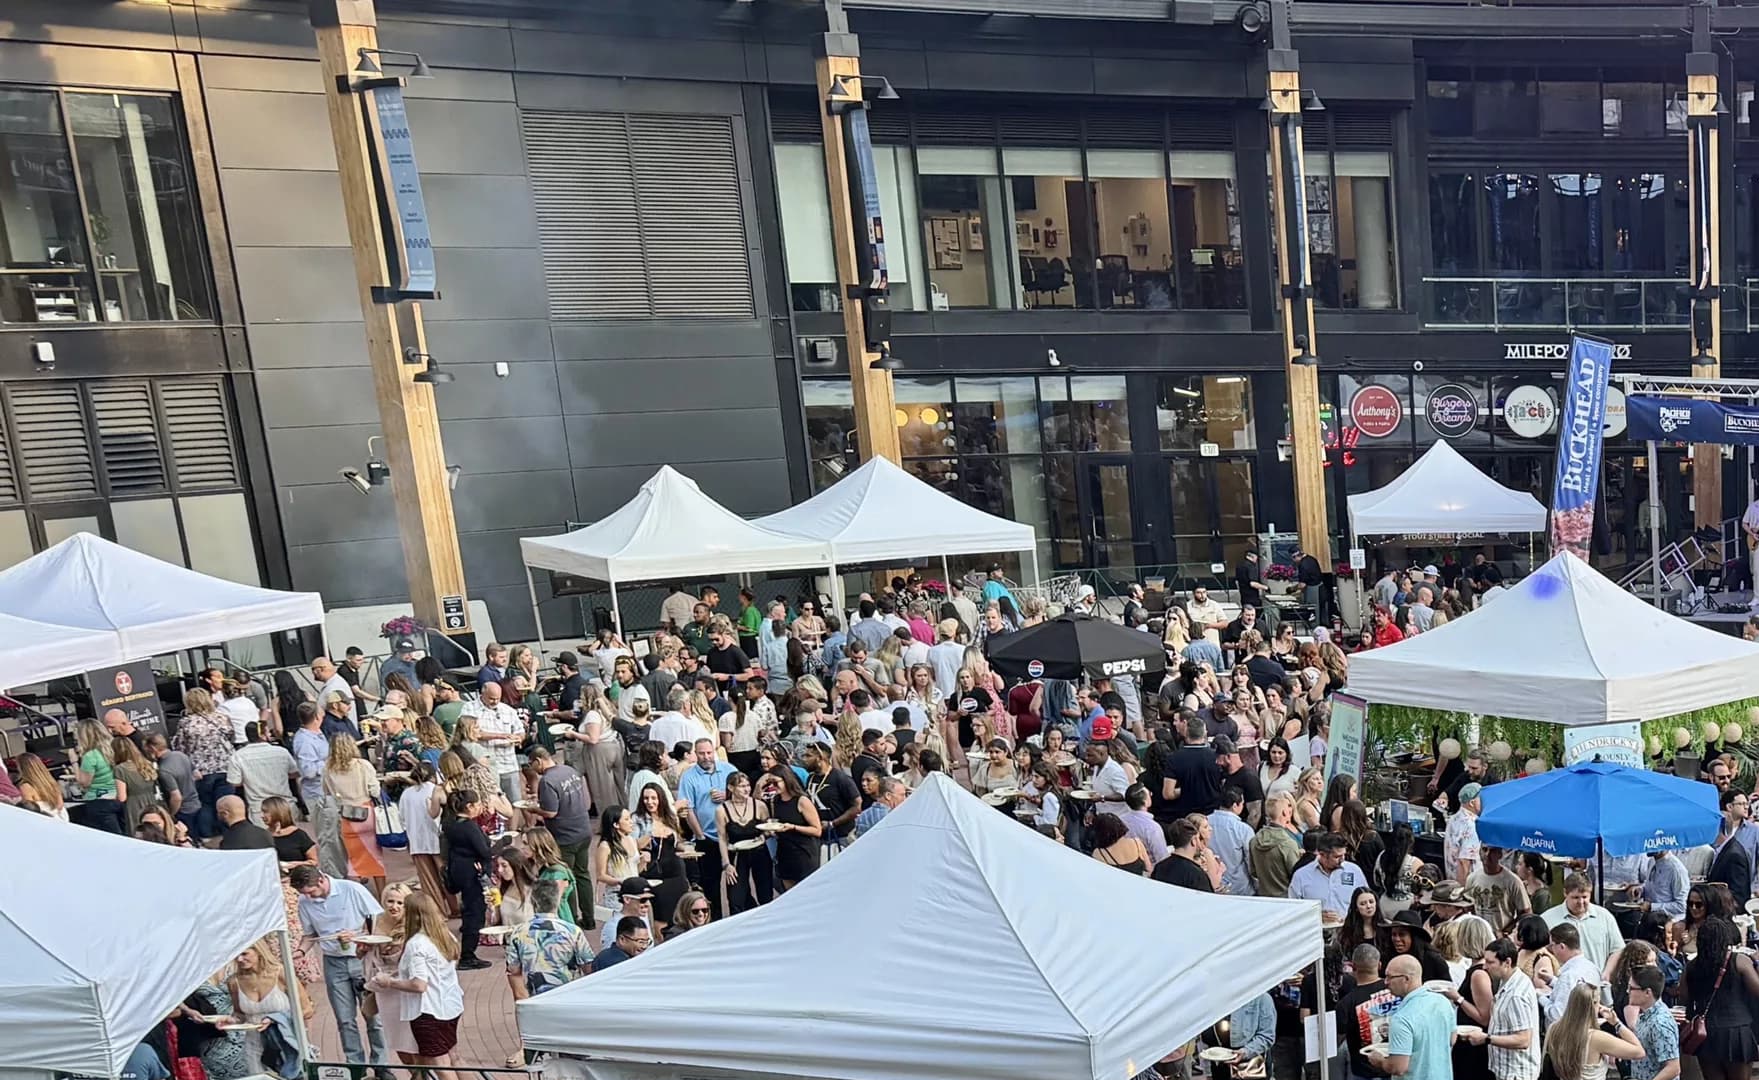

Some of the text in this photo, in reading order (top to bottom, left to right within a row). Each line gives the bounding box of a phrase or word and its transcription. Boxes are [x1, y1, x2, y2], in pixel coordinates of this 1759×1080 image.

[1506, 344, 1569, 359] MILEPO
[1357, 403, 1396, 419] Anthony's
[1432, 398, 1472, 409] Burgers
[1432, 413, 1472, 423] Dreams
[1562, 358, 1595, 493] BUCKHEAD
[1583, 474, 1591, 493] Meat
[1103, 658, 1146, 675] PEPSI
[1521, 836, 1556, 851] AQUAFINA
[1643, 836, 1679, 850] AQUAFINA
